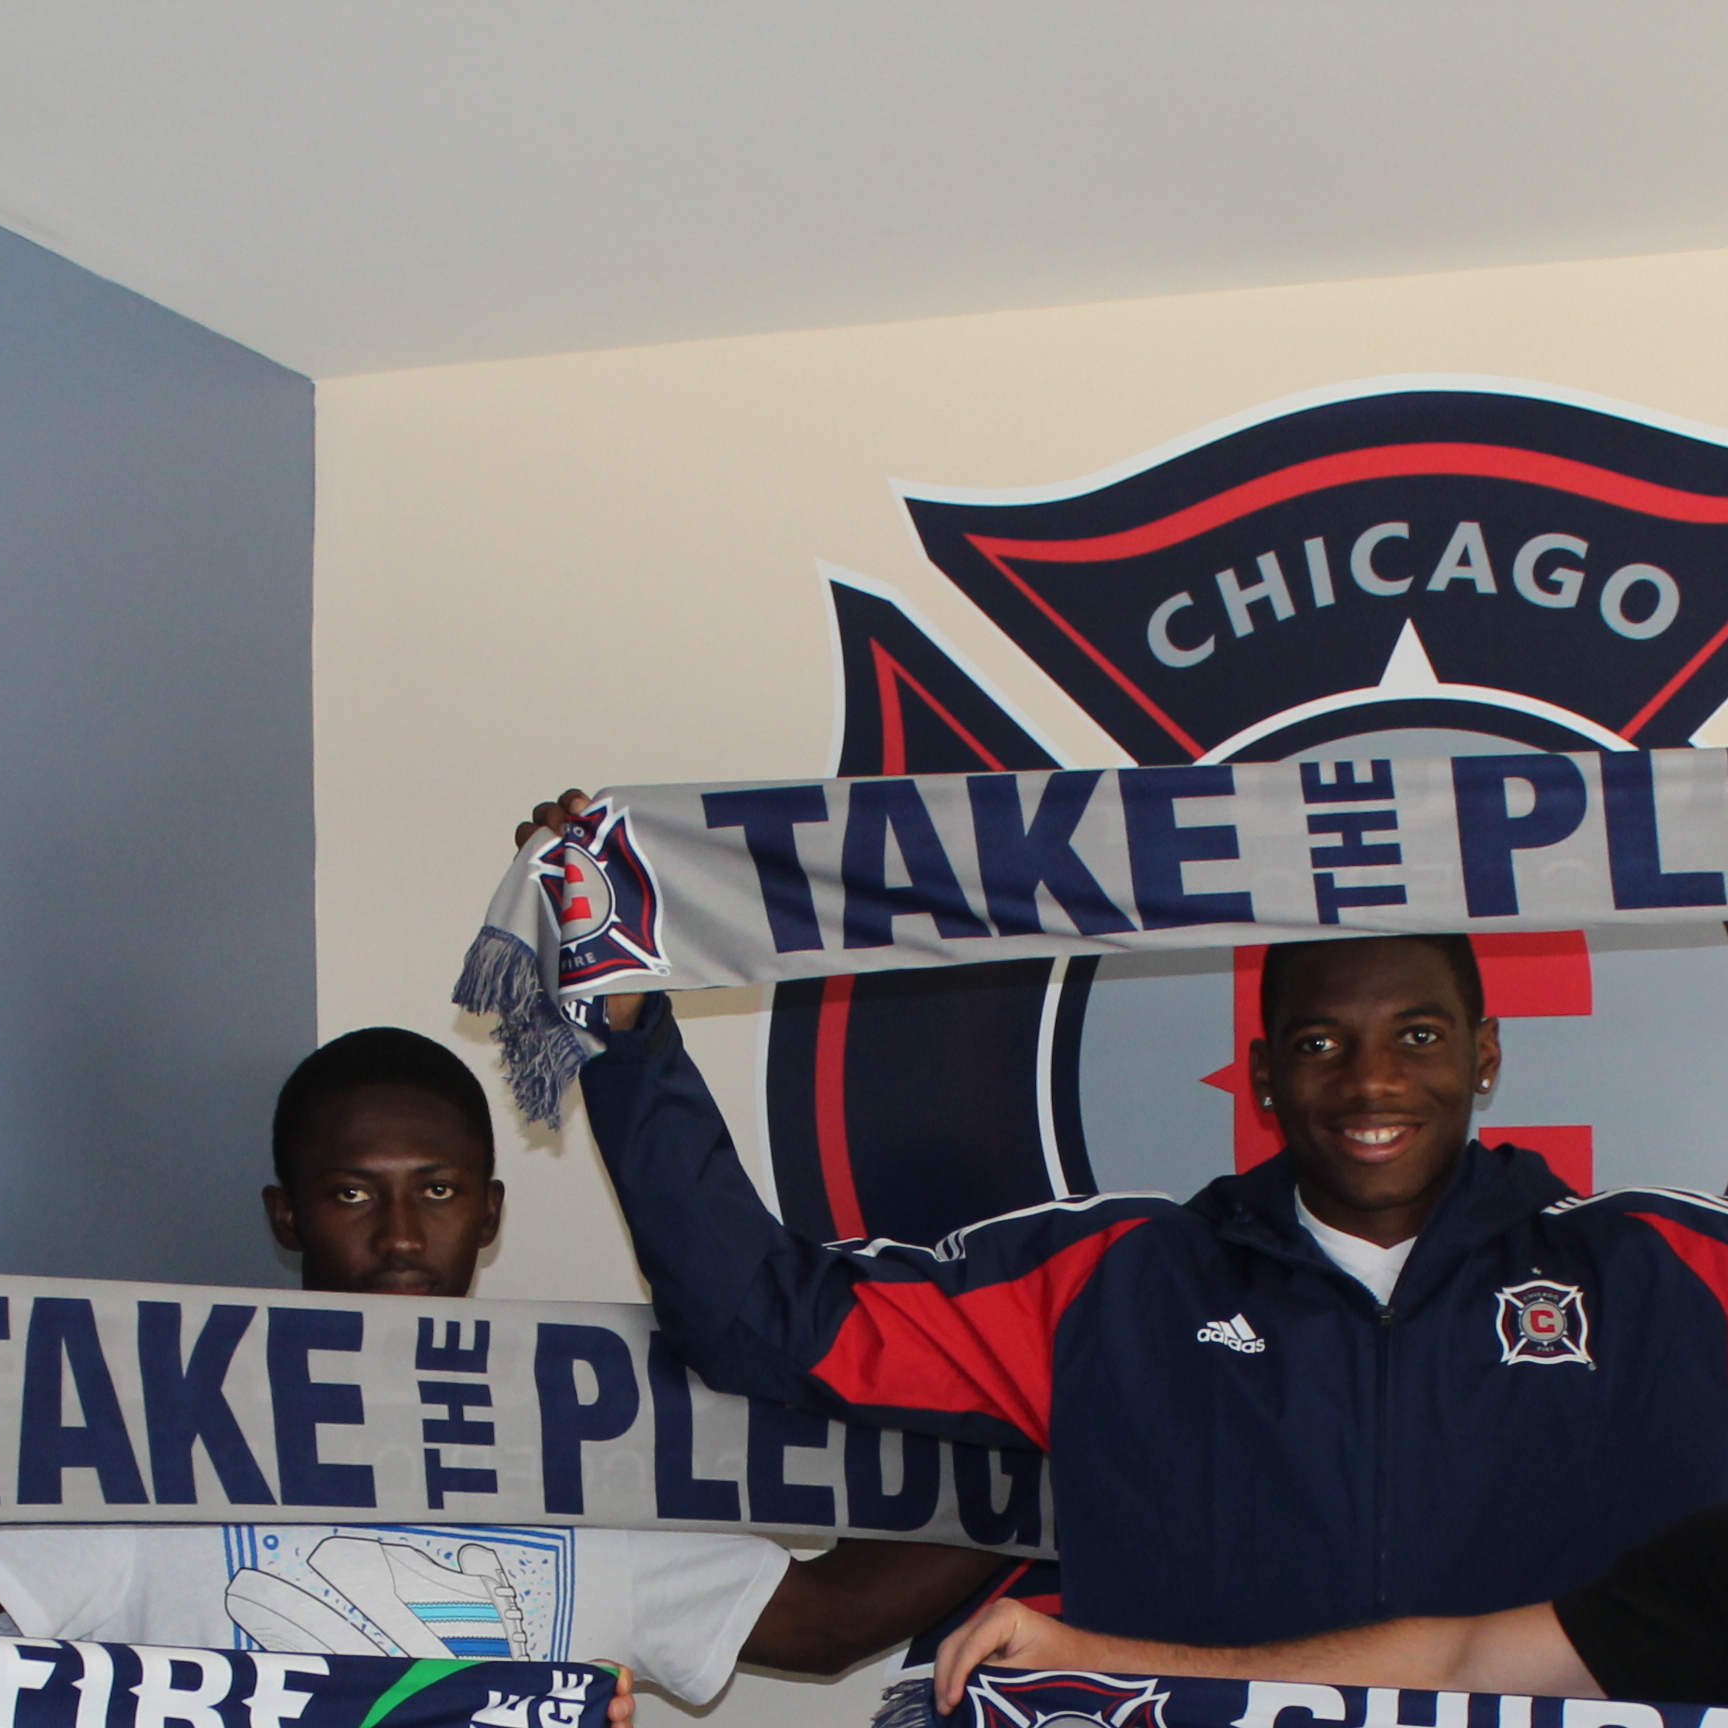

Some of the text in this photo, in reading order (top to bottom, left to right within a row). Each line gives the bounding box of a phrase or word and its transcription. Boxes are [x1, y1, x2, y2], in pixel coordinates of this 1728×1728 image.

[1146, 521, 1681, 668] CHICAGO
[700, 764, 1257, 954] TAKE
[1299, 758, 1408, 925] THE
[1197, 1328, 1266, 1354] adidas
[415, 1317, 498, 1510] THE
[534, 1322, 1059, 1550] PLEDG
